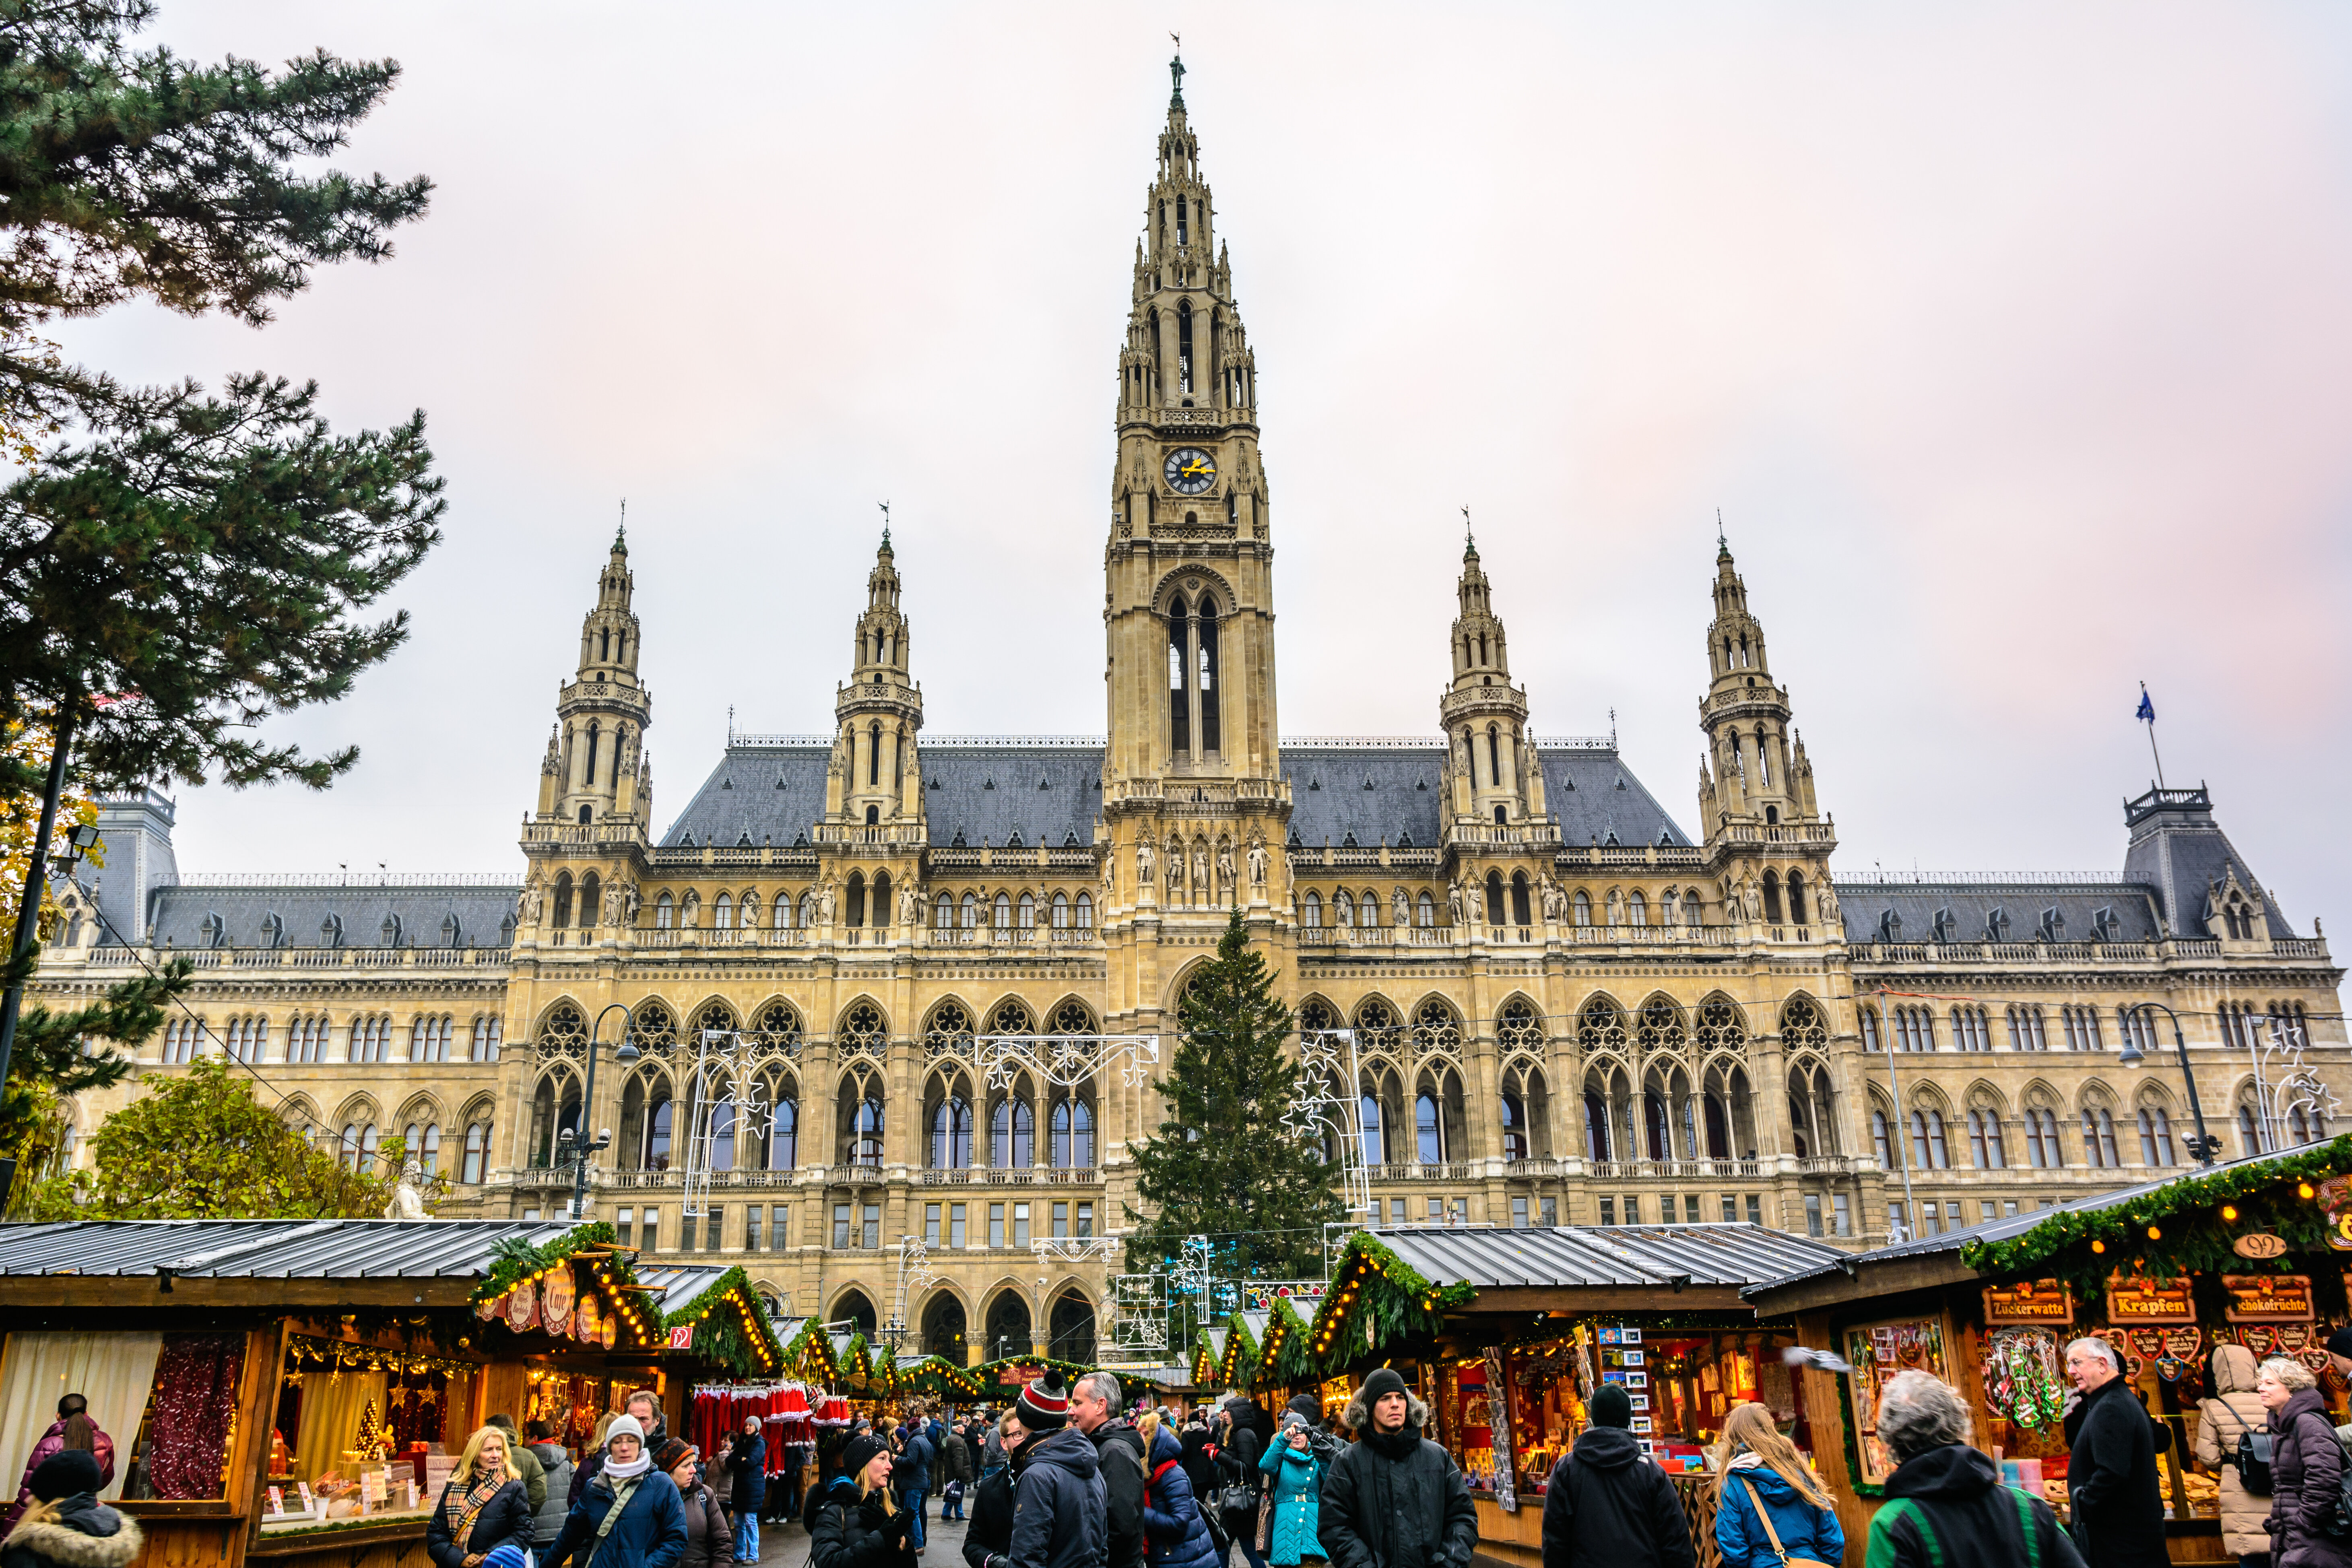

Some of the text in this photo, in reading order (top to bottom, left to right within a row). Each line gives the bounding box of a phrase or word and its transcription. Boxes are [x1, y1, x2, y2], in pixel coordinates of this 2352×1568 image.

[2247, 1236, 2277, 1256] 92
[550, 1286, 566, 1312] Café
[1993, 1302, 2064, 1315] Zuckerwatte
[2117, 1298, 2186, 1316] Krapfen
